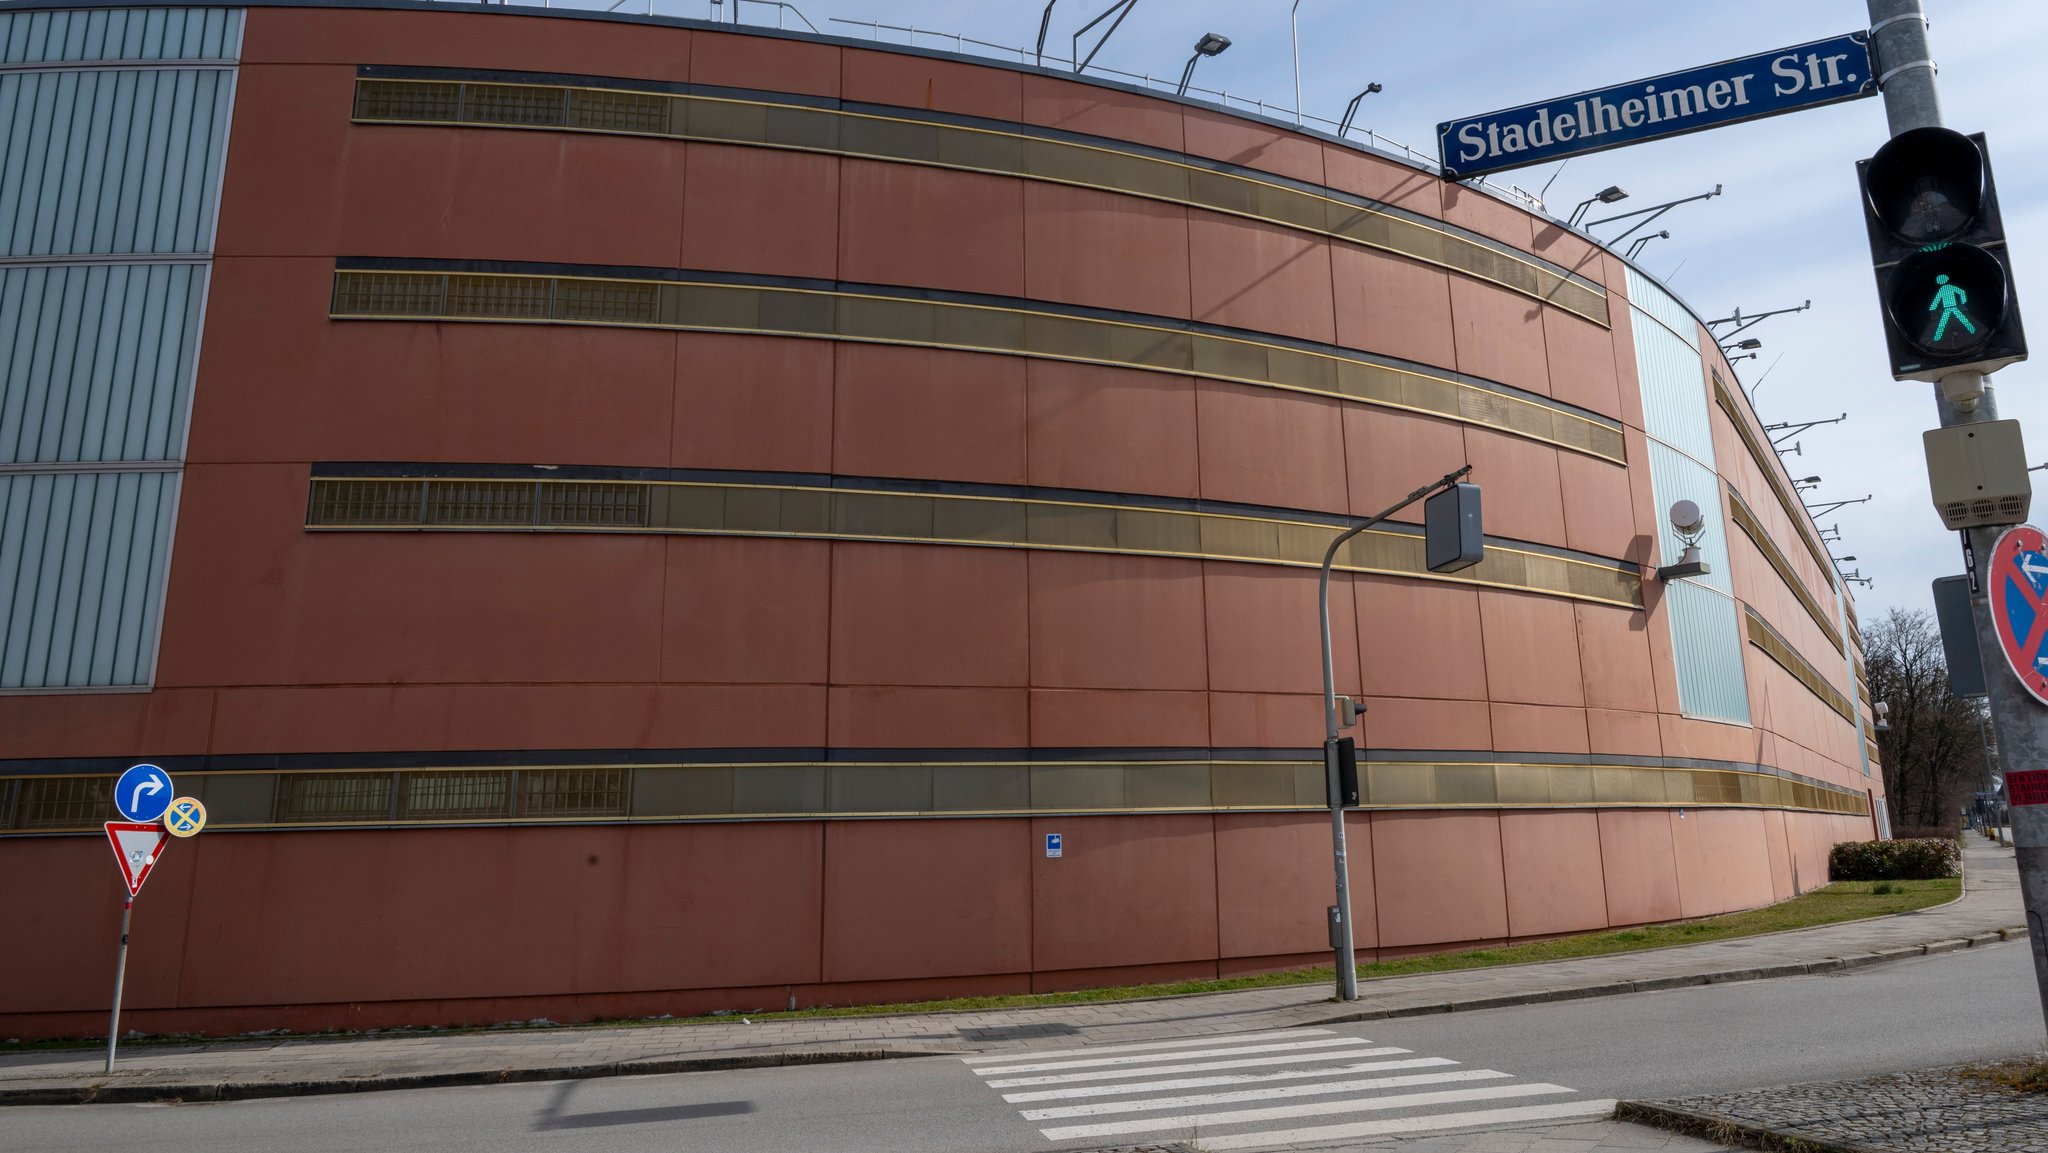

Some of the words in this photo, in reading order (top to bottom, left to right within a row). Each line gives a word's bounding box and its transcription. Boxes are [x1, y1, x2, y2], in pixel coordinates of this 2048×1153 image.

[1458, 73, 1754, 163] Stadelheimer
[1771, 53, 1857, 97] Str.
[2009, 782, 2048, 793] STADIO
[2012, 792, 2048, 802] VERBO
